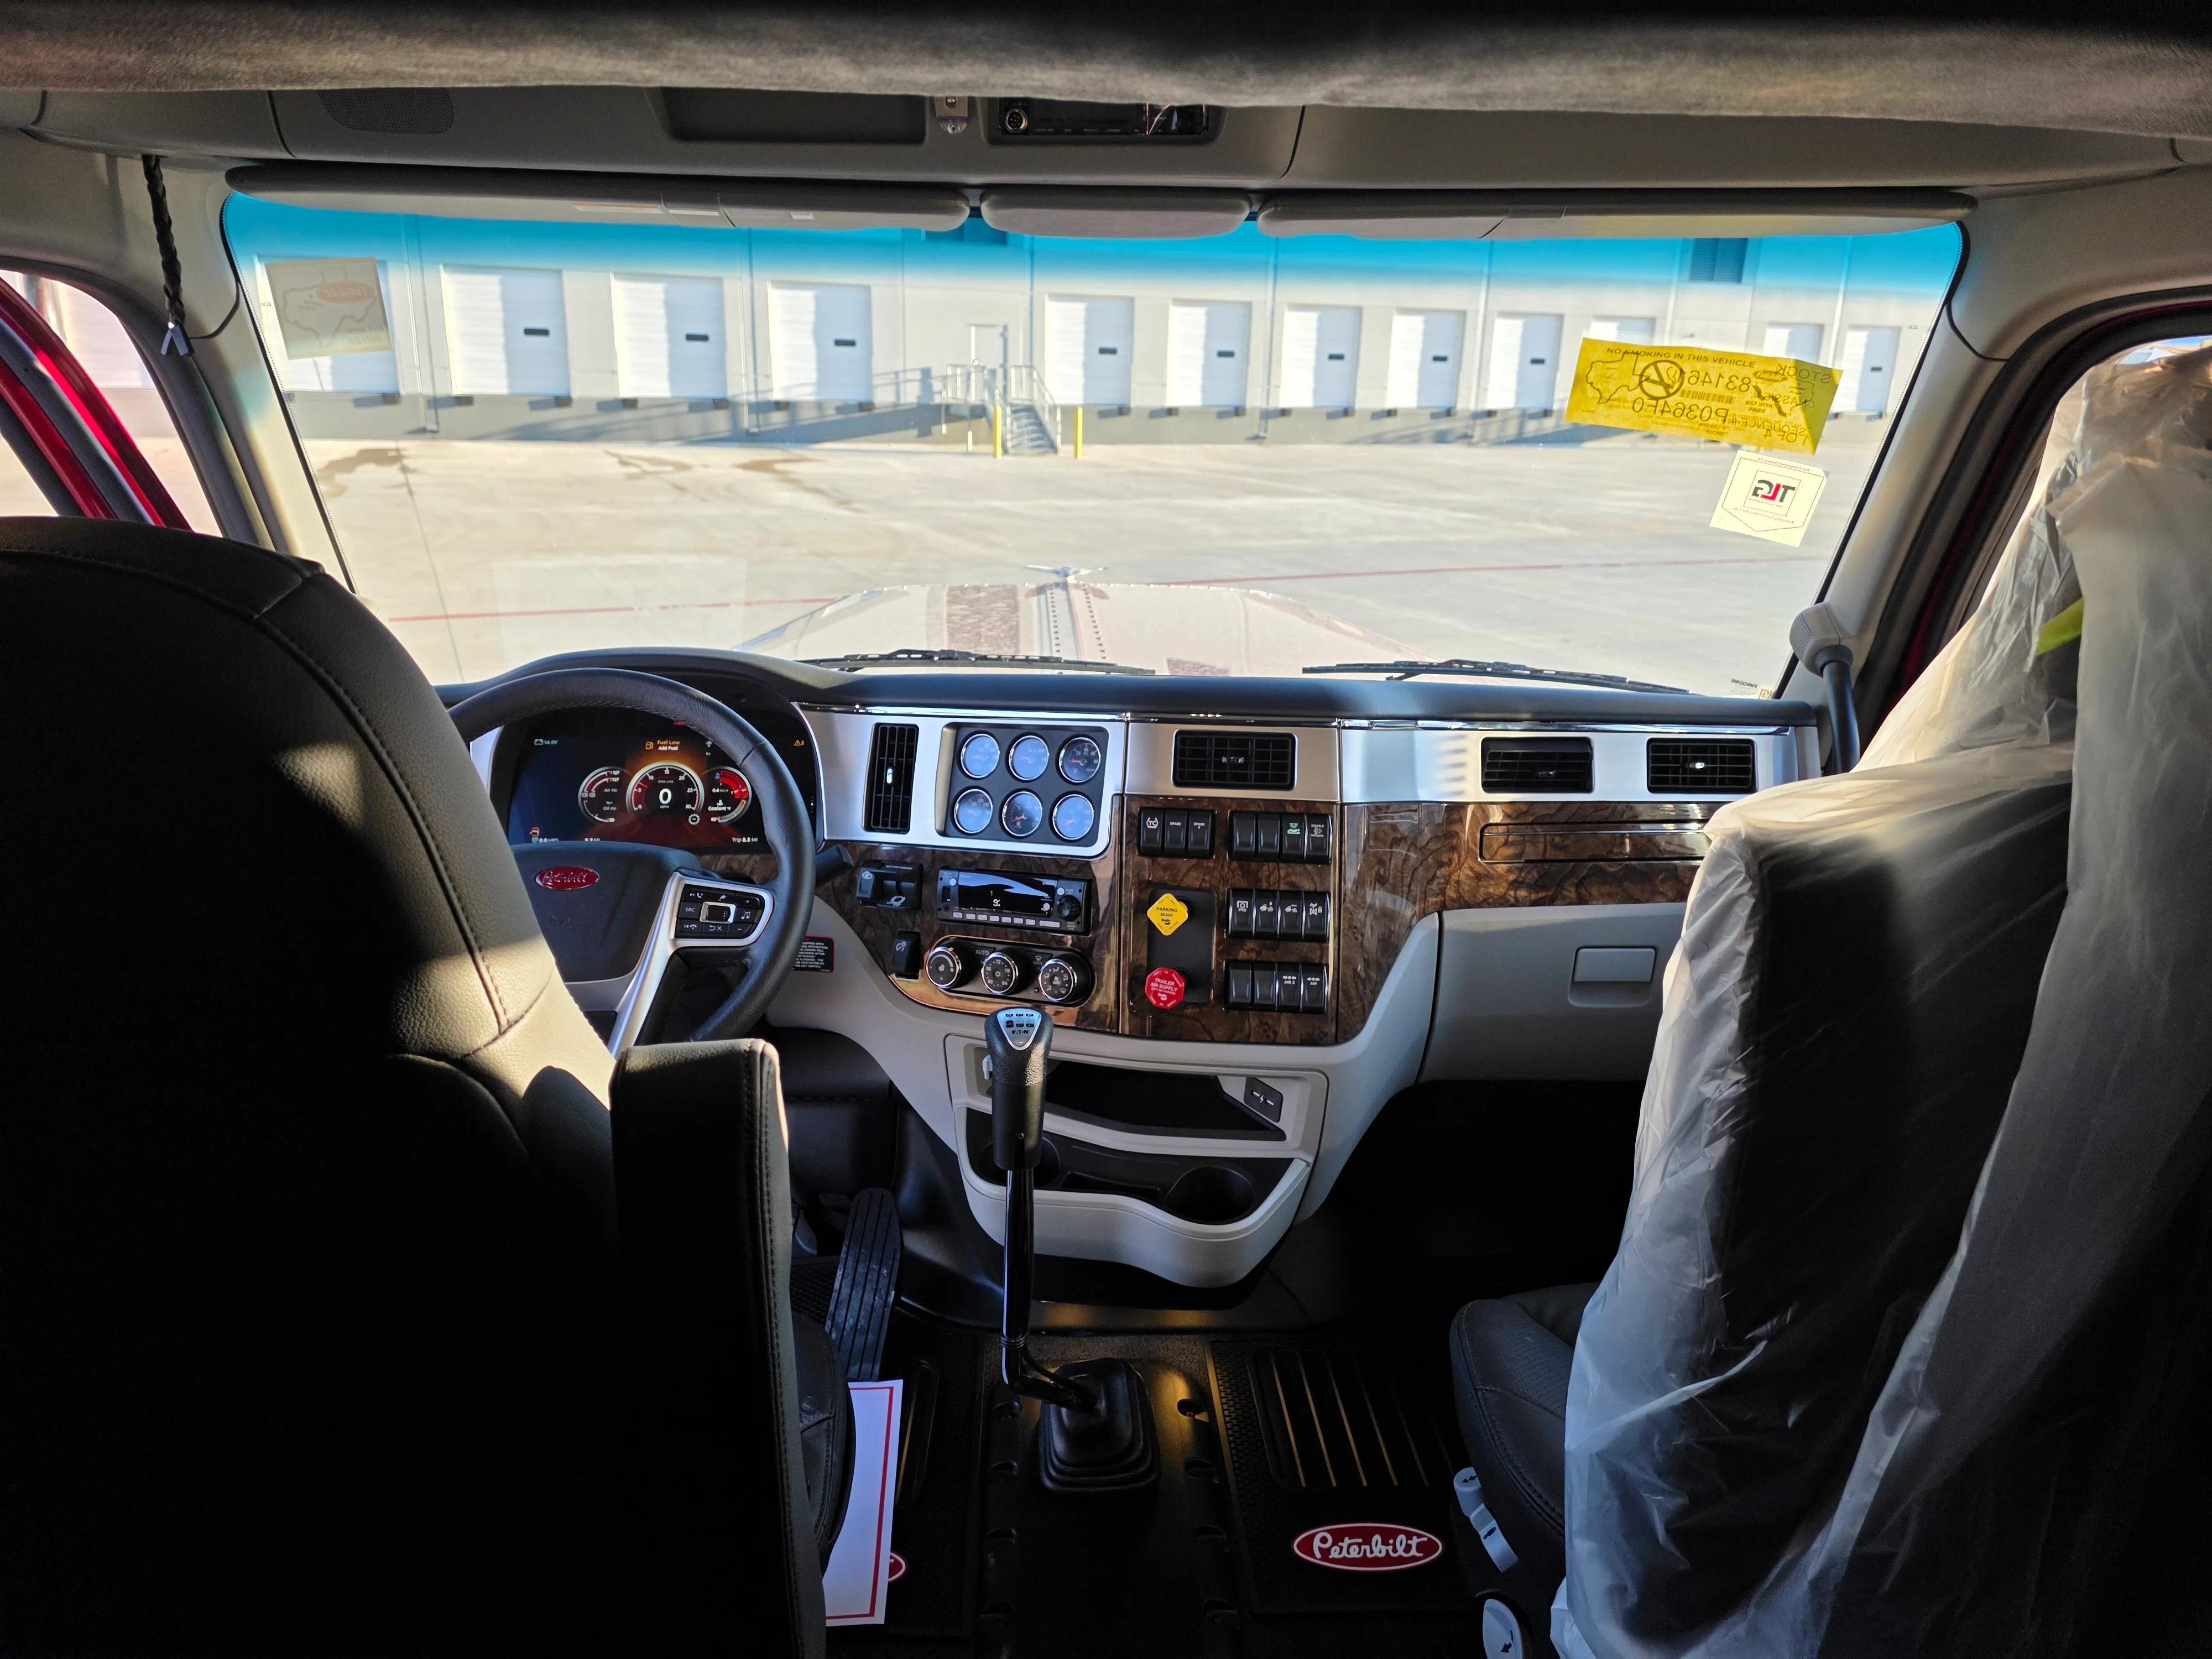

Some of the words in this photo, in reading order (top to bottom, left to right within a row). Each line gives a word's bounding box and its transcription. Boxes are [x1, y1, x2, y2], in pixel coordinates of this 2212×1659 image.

[1624, 349, 1671, 358] SMOKING
[1713, 357, 1756, 368] VEHICLE
[659, 788, 672, 805] 0
[542, 871, 588, 883] Peterbilt
[1155, 977, 1175, 987] TRAILER
[1159, 984, 1178, 992] SUPPLY
[1313, 1531, 1428, 1559] Peterbilt
